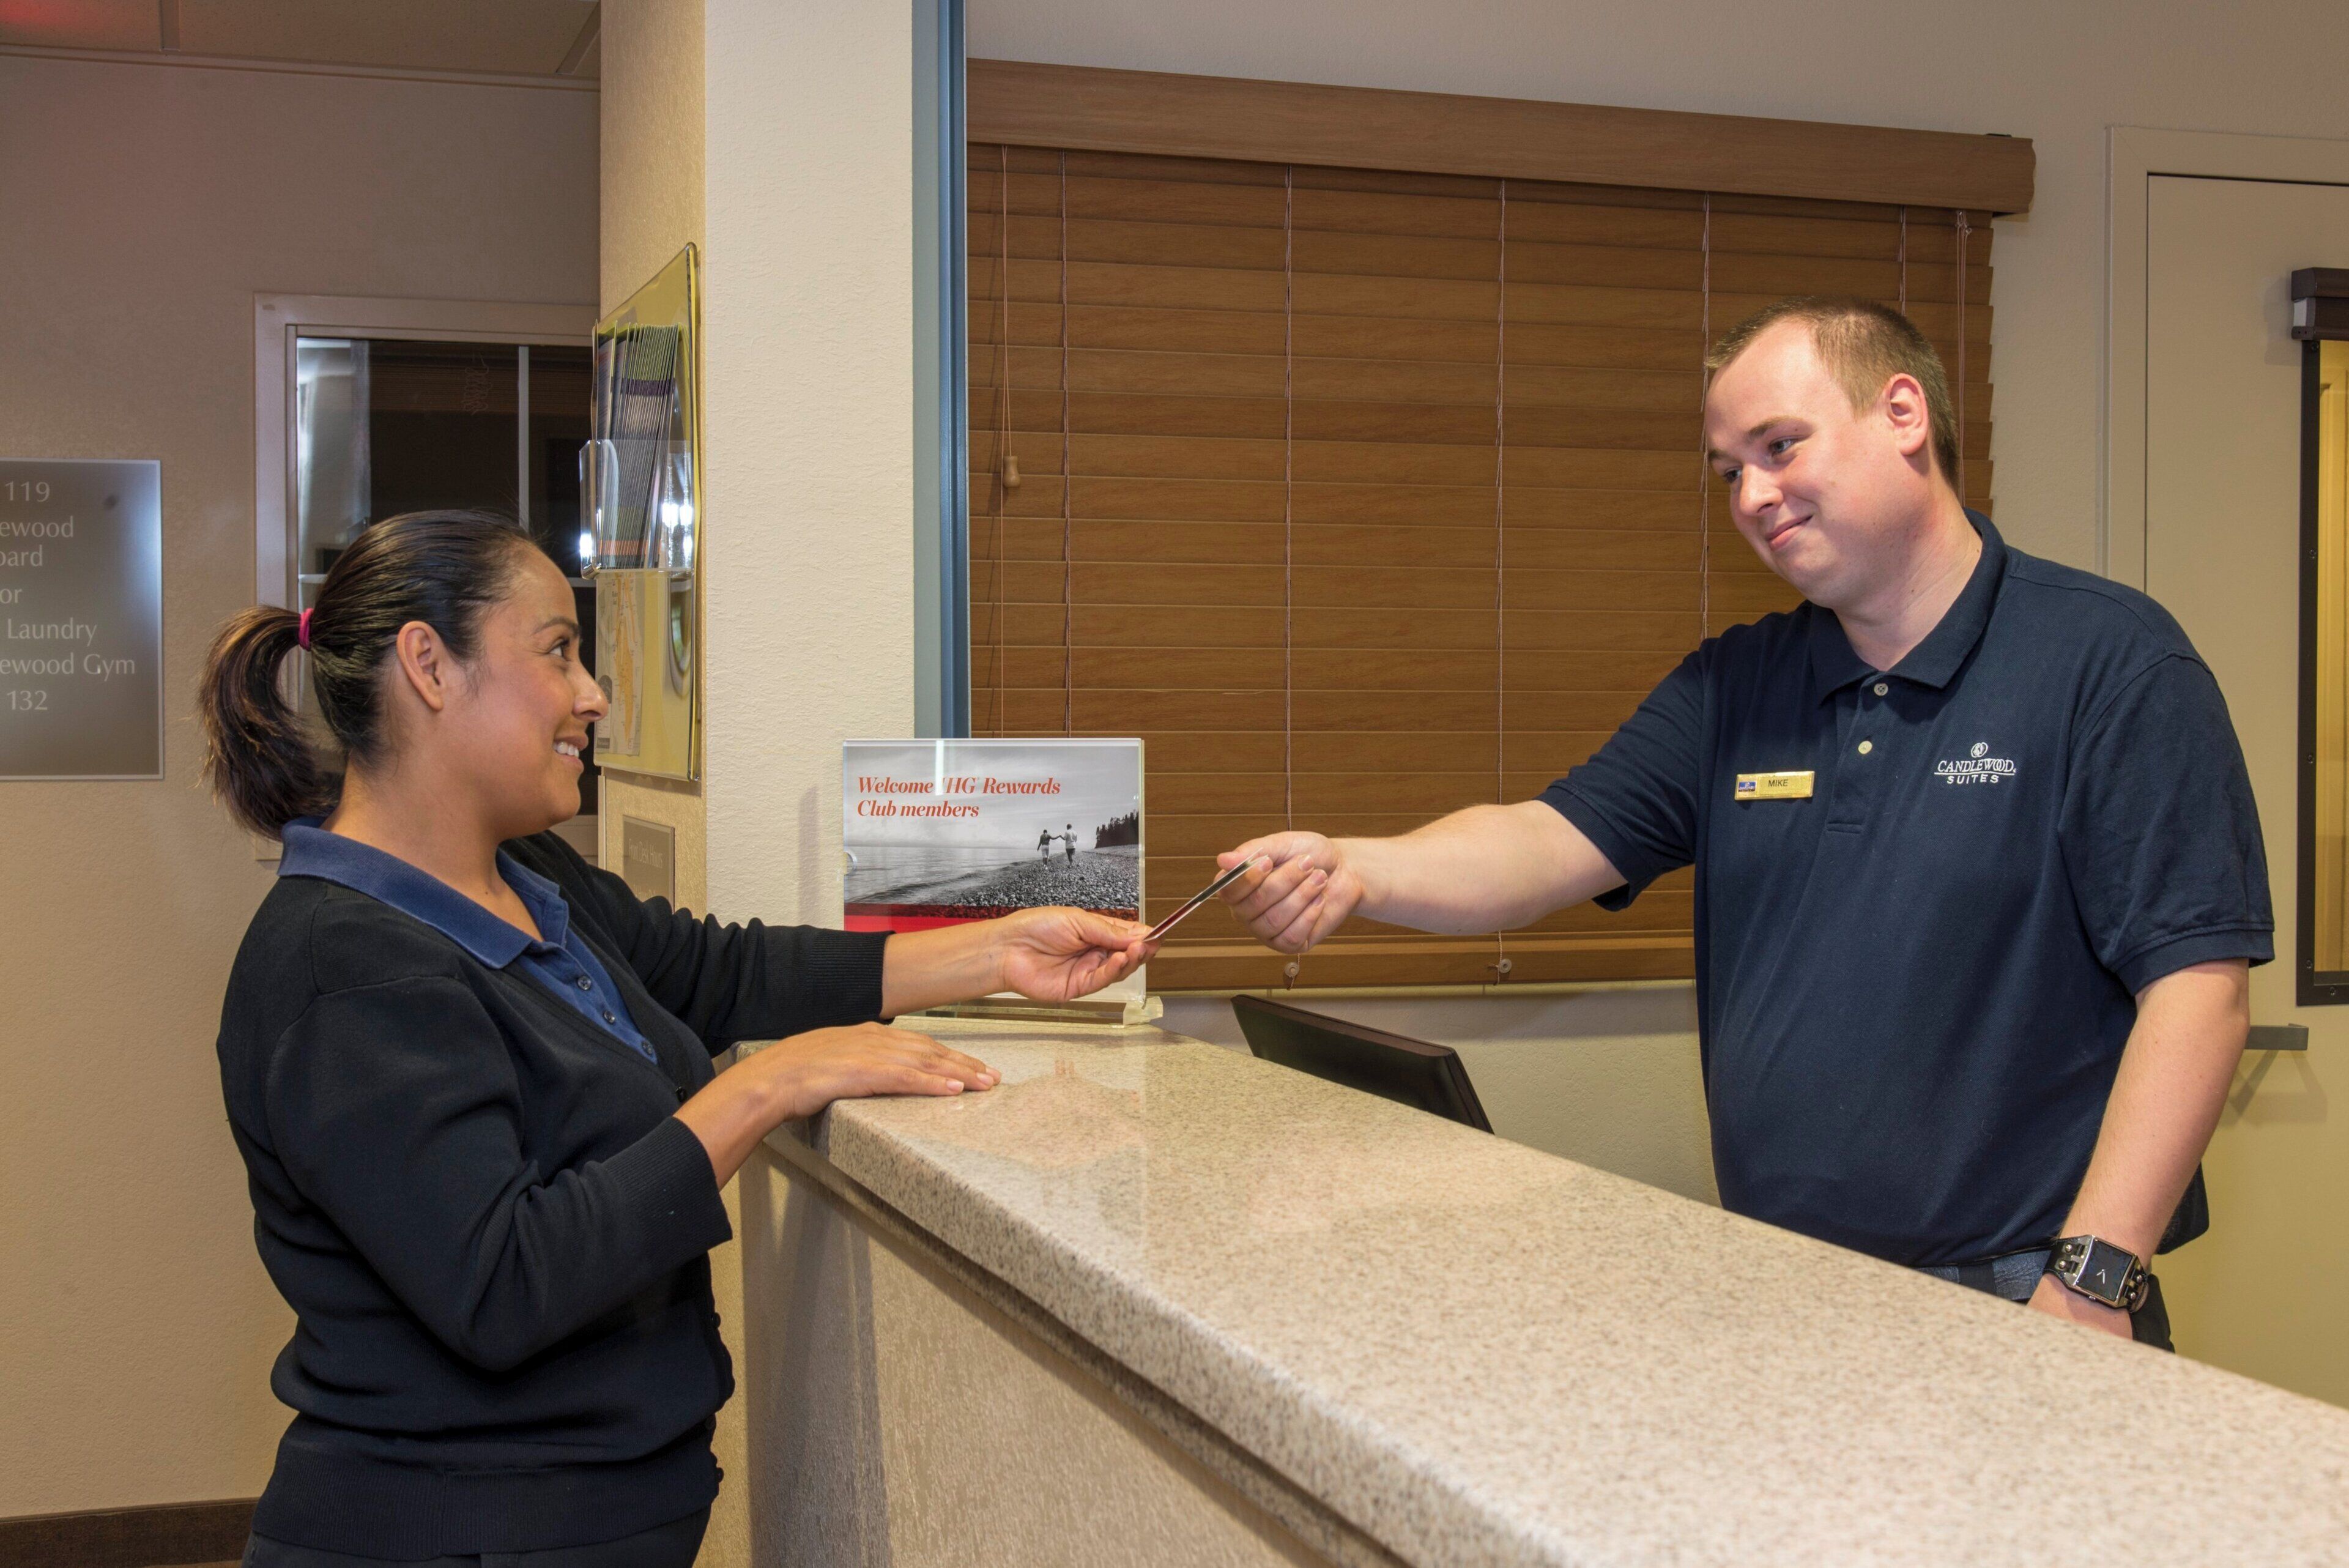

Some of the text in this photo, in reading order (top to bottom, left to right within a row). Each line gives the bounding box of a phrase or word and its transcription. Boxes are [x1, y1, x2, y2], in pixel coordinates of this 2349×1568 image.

[5, 481, 50, 502] 119
[7, 617, 97, 647] Laundry
[83, 653, 135, 682] Gym
[7, 690, 48, 710] 132
[1937, 758, 2014, 773] CANDLEWOOD
[858, 776, 1061, 794] Welcome HG Rewards
[1768, 779, 1789, 787] MIKE
[1946, 774, 1999, 784] SUITES
[857, 800, 979, 817] Club members
